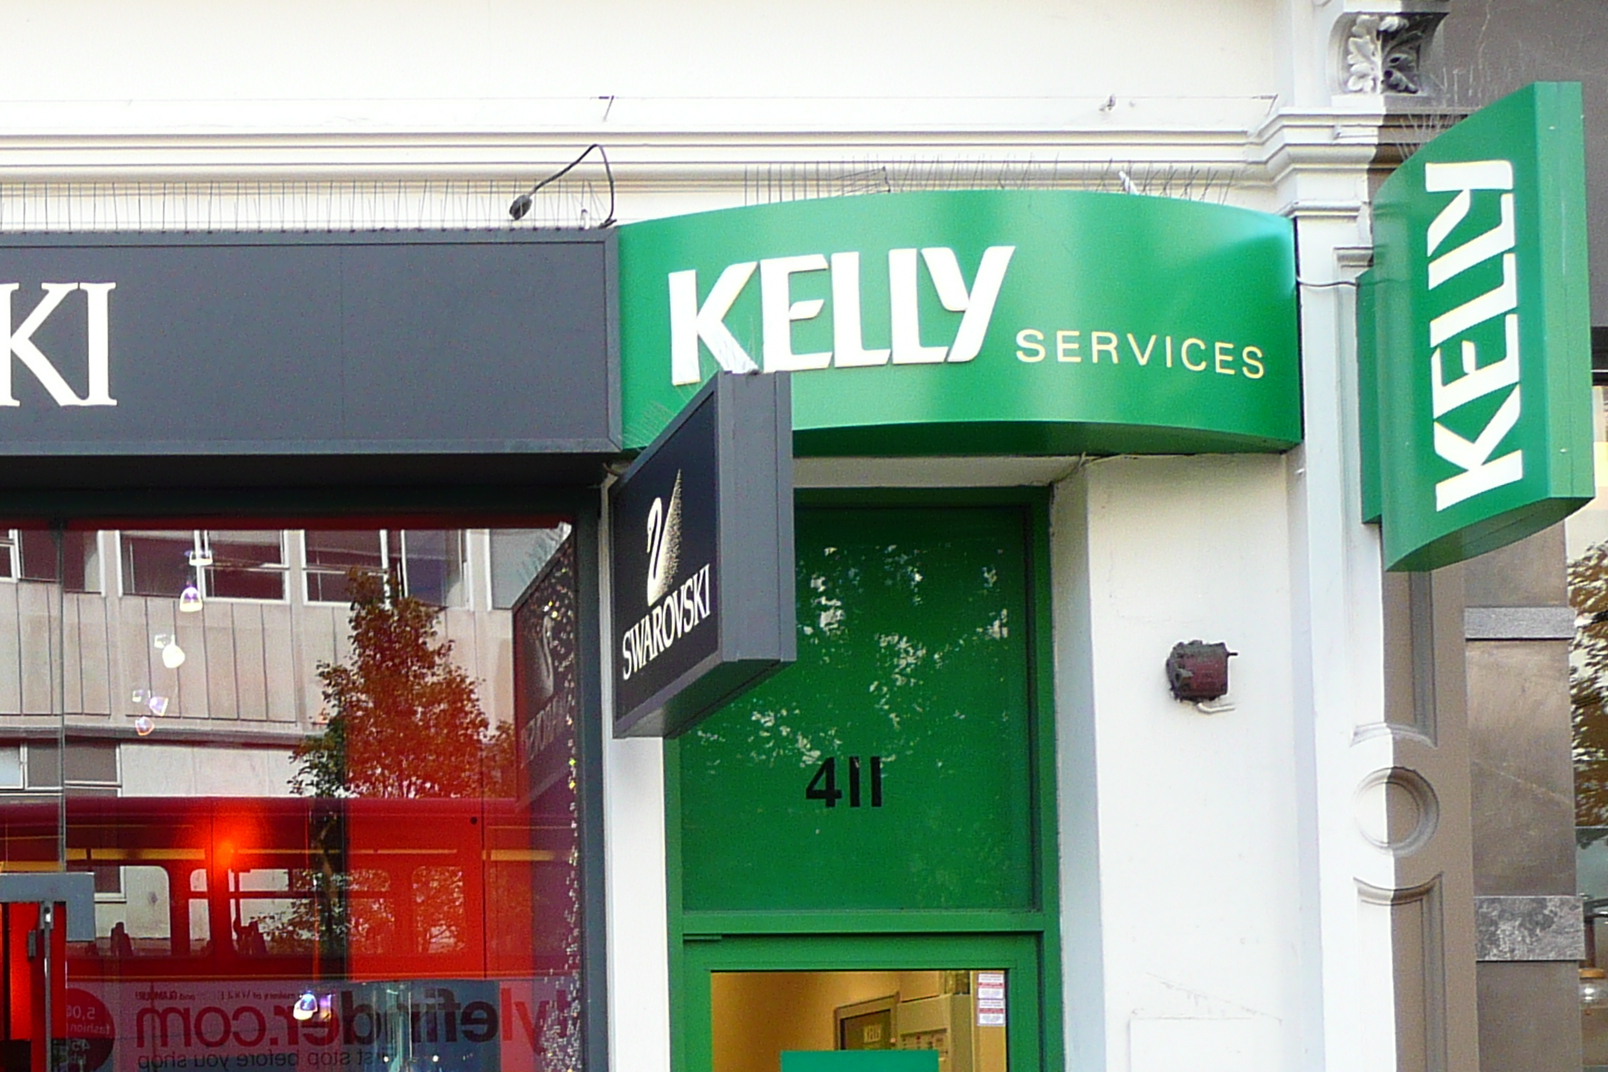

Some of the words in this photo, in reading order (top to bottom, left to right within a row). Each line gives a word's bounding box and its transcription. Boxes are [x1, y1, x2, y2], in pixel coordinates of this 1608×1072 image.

[668, 245, 1016, 386] KELLY
[1014, 328, 1266, 380] SERVICES
[1425, 160, 1523, 513] KELLY
[622, 563, 711, 681] SWAROVSKI
[806, 756, 882, 808] 411
